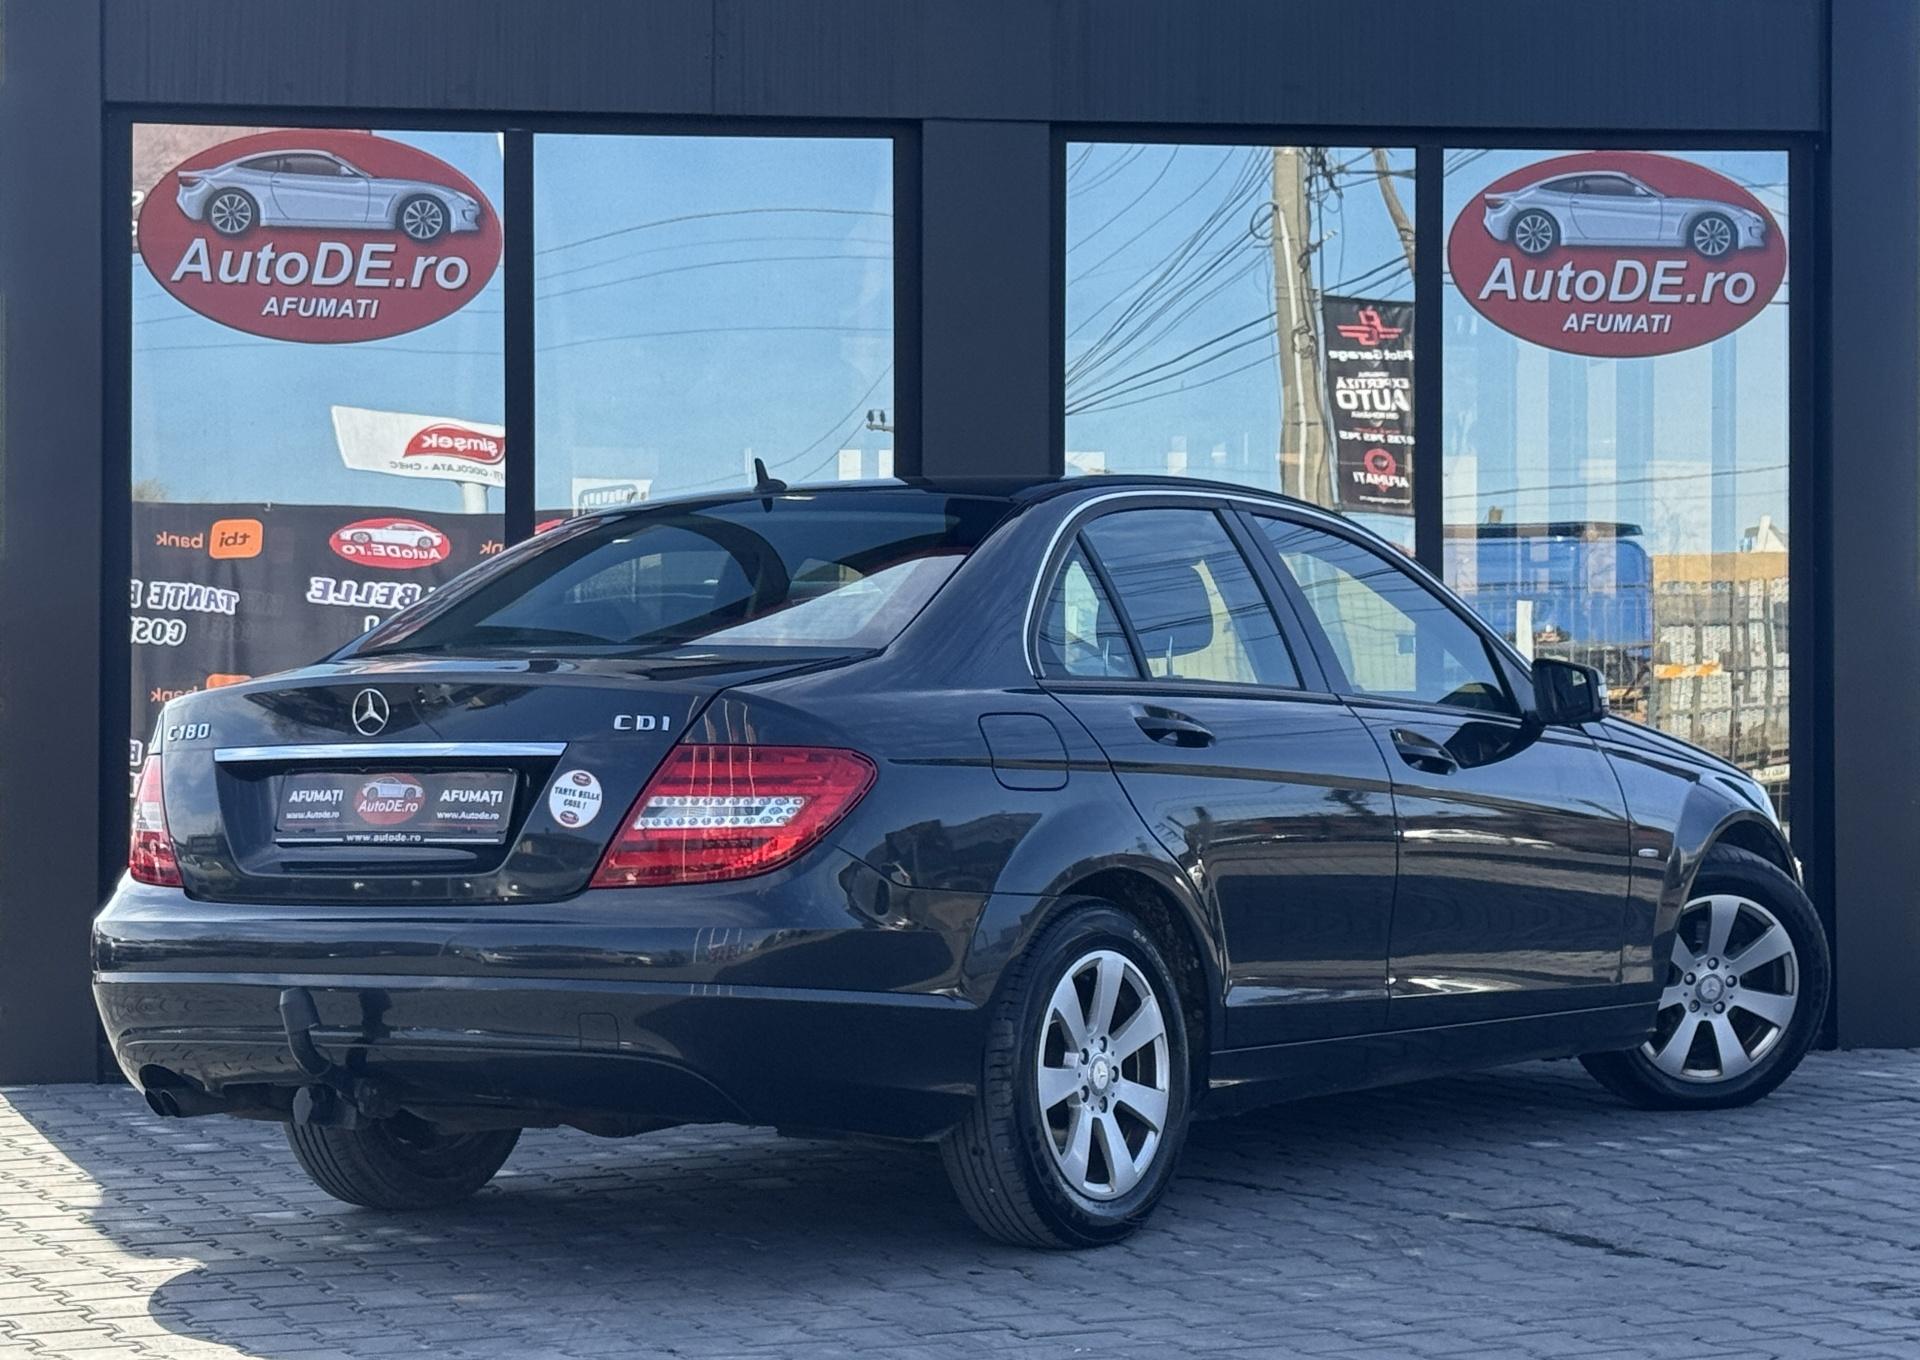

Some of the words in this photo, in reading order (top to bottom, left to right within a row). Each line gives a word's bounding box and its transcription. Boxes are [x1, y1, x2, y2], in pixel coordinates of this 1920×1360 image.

[171, 238, 470, 290] AutoDE.ro
[1478, 257, 1756, 304] AutoDE.ro
[262, 296, 379, 319] AFUMATI
[1563, 313, 1671, 333] AFUMATI
[613, 714, 671, 731] CDI
[357, 799, 419, 814] AutoDE.ro
[346, 832, 422, 843] www.autode.ro
